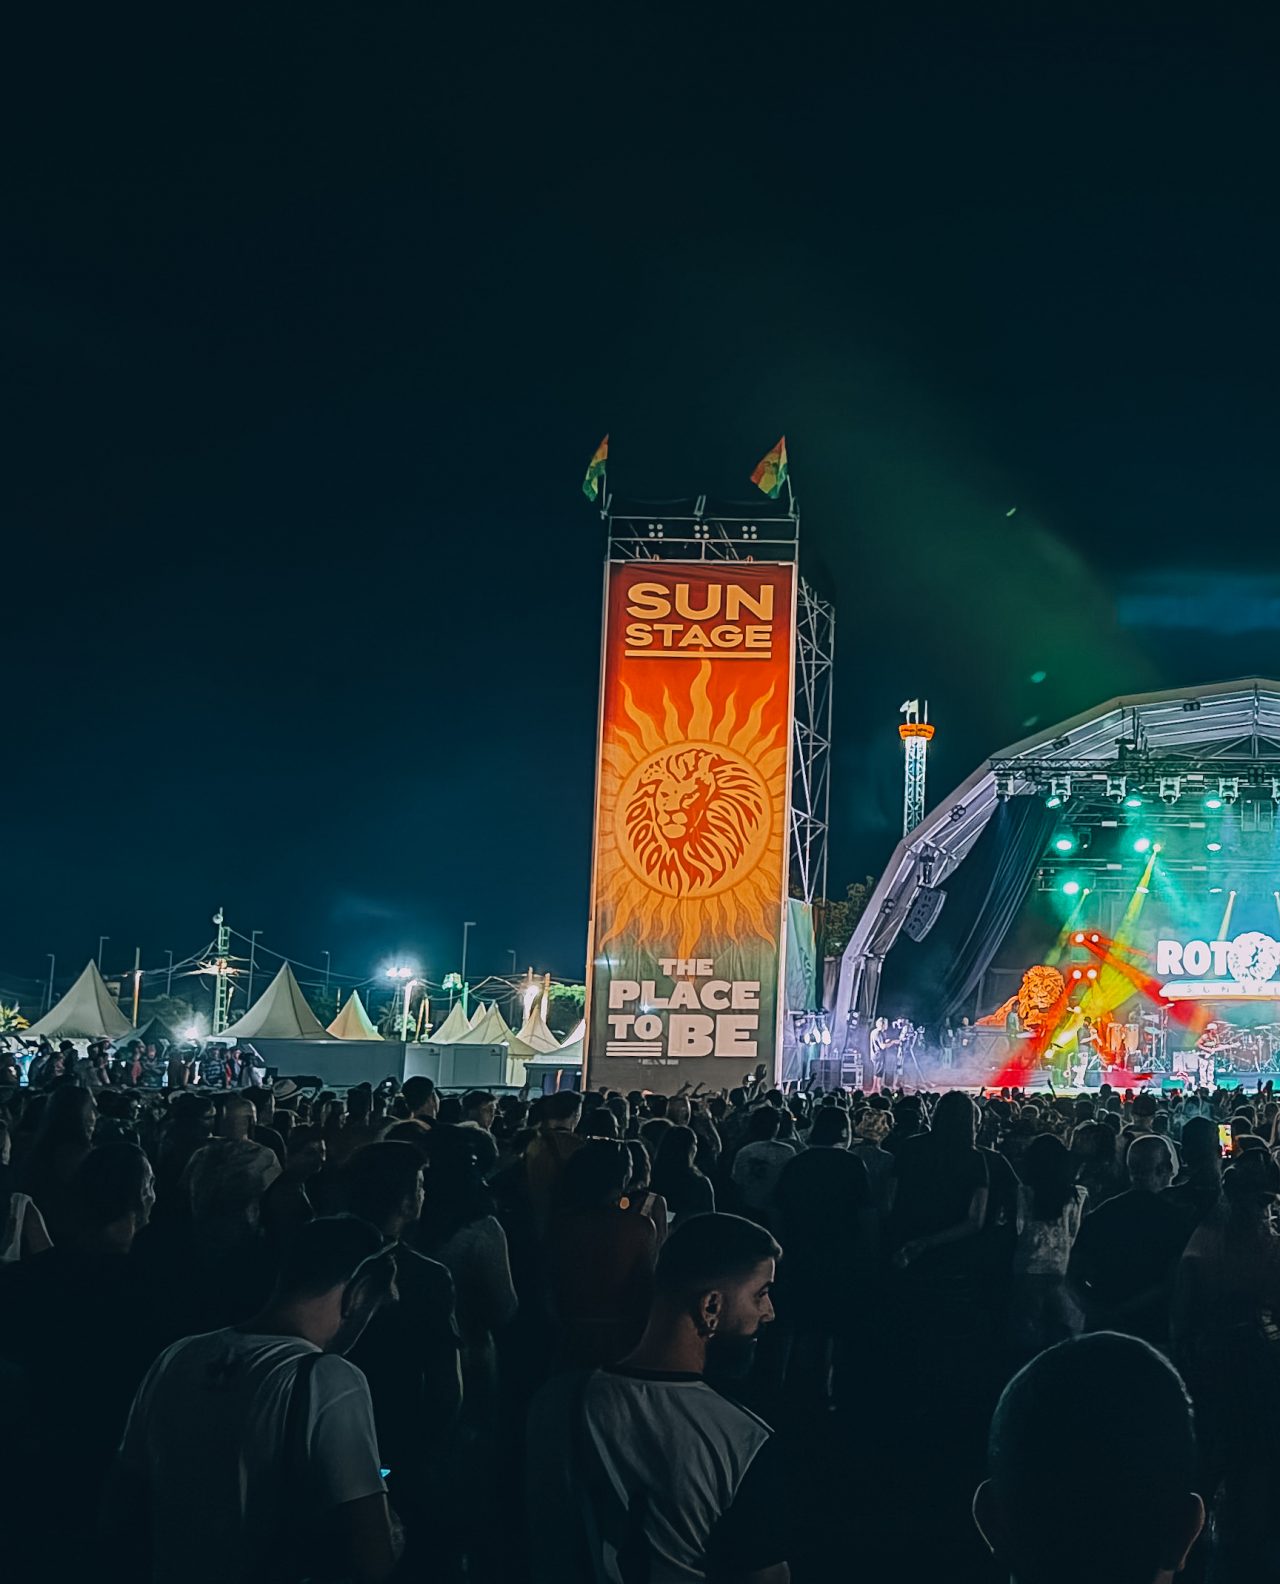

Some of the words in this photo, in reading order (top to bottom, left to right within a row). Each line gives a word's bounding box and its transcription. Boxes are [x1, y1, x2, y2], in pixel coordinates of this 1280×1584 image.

[626, 582, 774, 621] SUN
[625, 622, 773, 648] STAGE
[658, 958, 714, 976] THE
[608, 980, 761, 1010] PLACE
[608, 1014, 663, 1040] TO
[667, 1014, 759, 1057] BE
